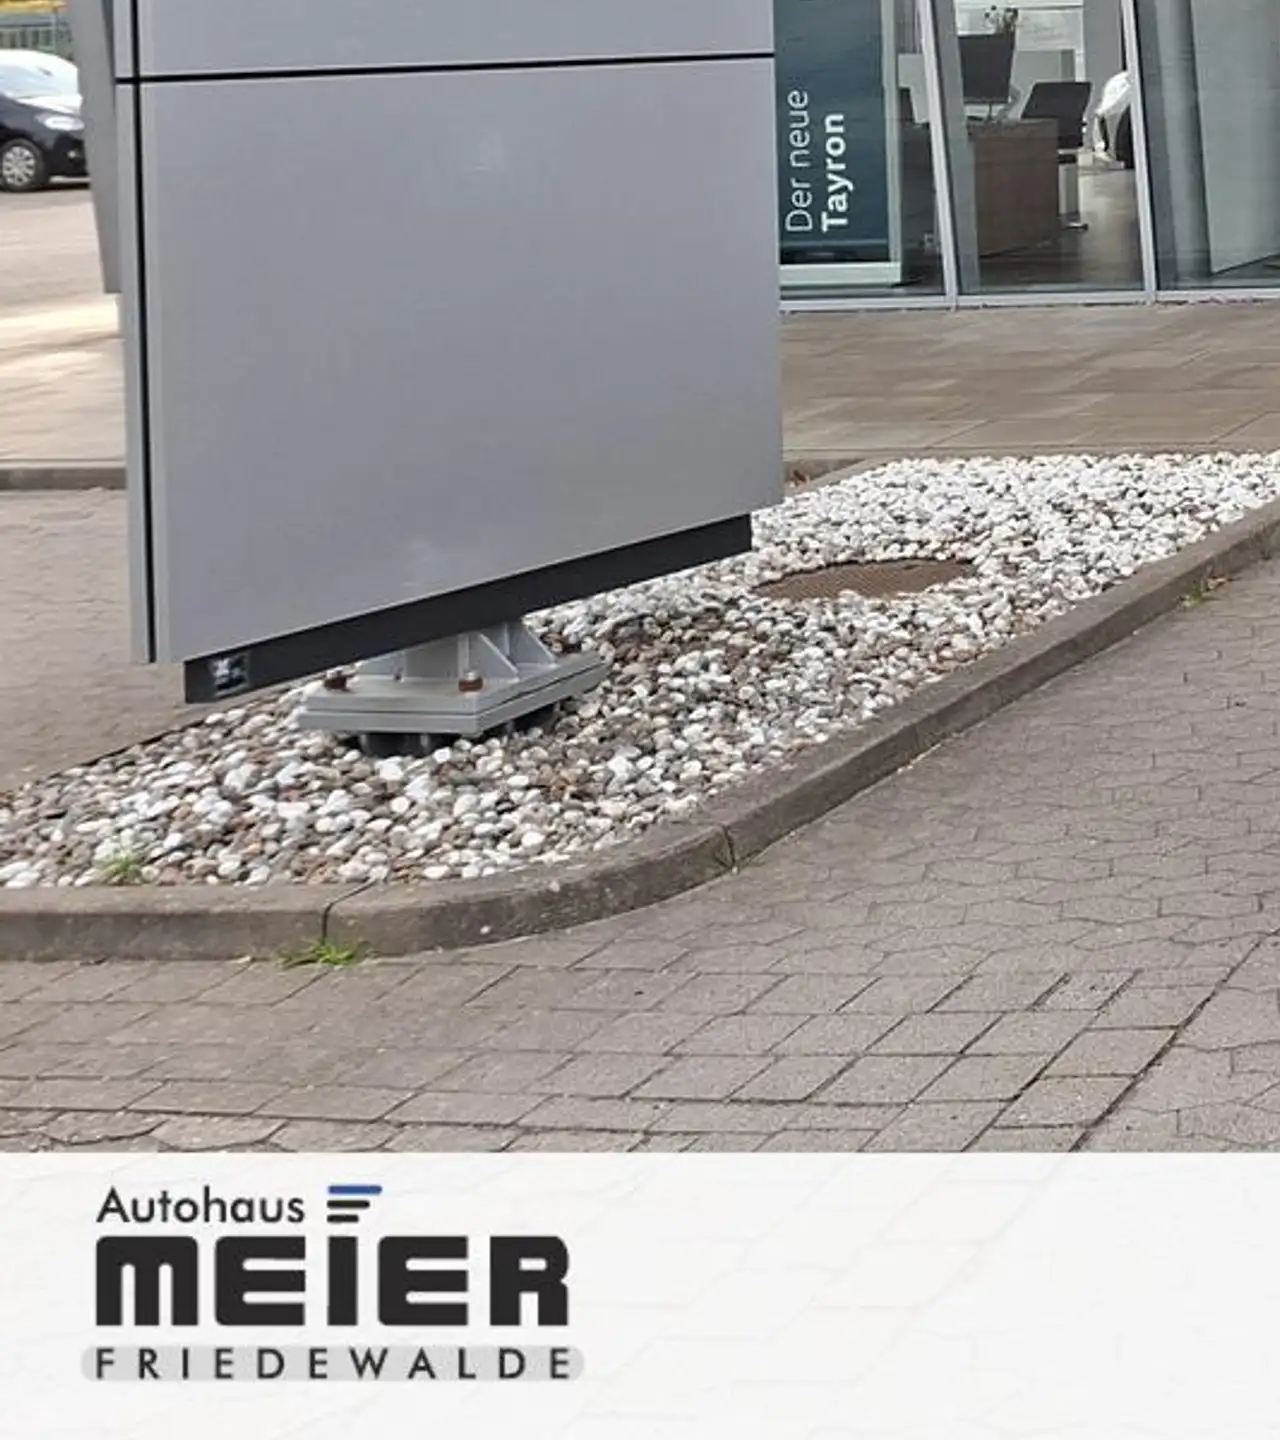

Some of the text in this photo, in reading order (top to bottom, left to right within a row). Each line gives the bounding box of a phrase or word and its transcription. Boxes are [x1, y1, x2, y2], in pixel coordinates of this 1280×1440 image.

[784, 89, 813, 232] Der neue
[820, 113, 854, 232] Tayron
